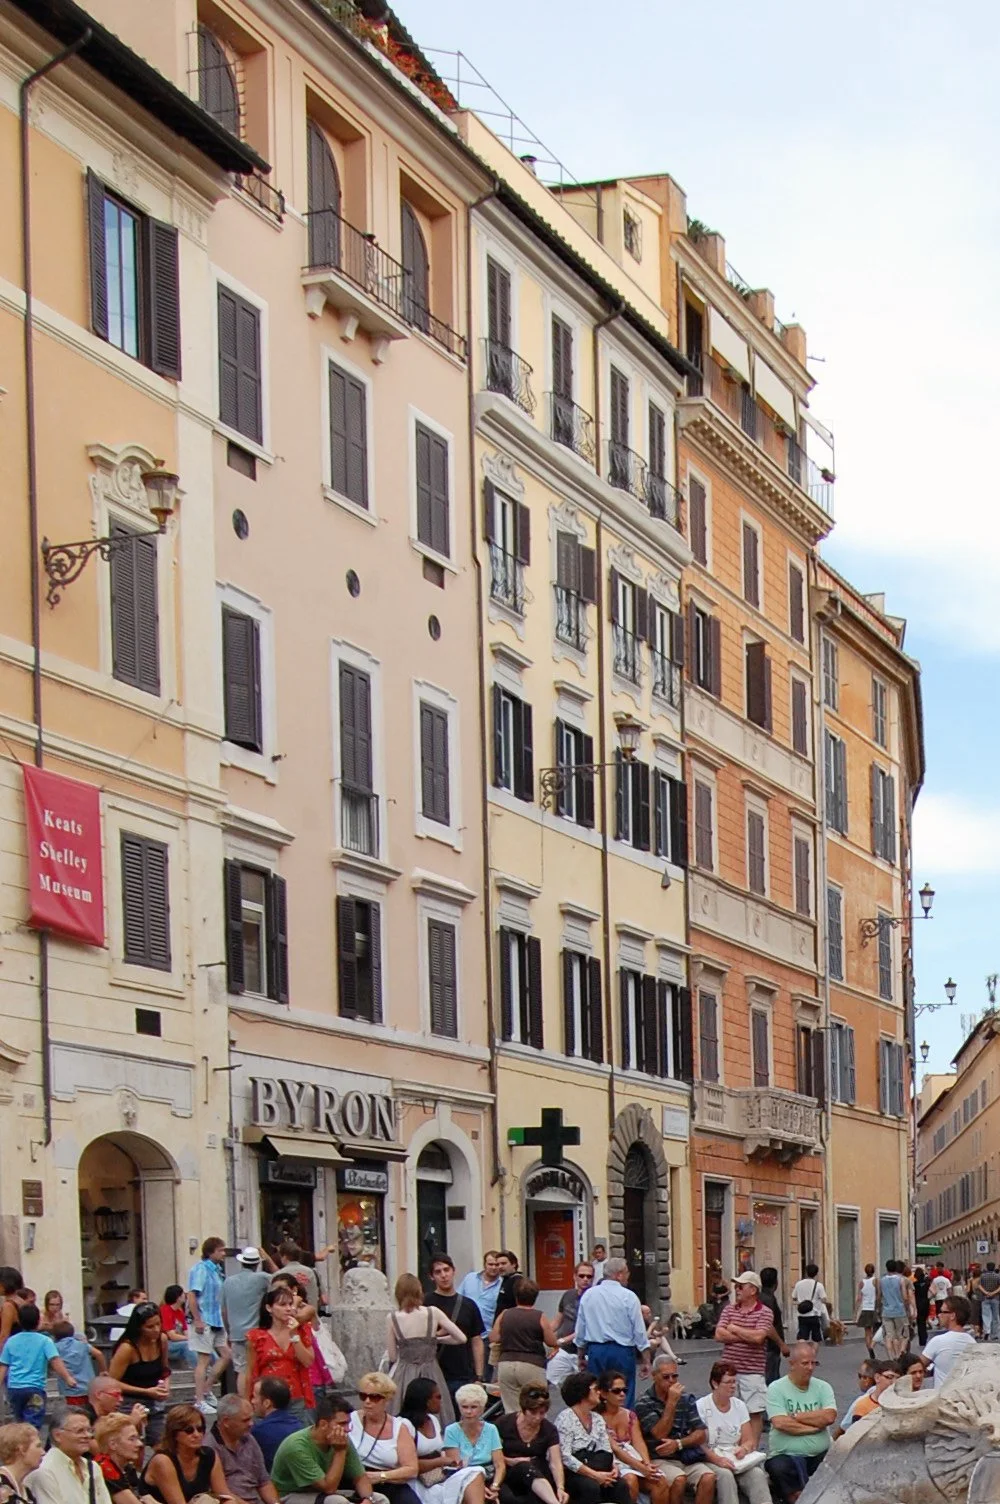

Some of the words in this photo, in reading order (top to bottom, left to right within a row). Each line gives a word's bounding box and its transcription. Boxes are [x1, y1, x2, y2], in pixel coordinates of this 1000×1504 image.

[44, 809, 83, 836] Keats
[40, 841, 87, 874] Shelley
[39, 873, 93, 903] Museum
[249, 1076, 397, 1141] BYRON
